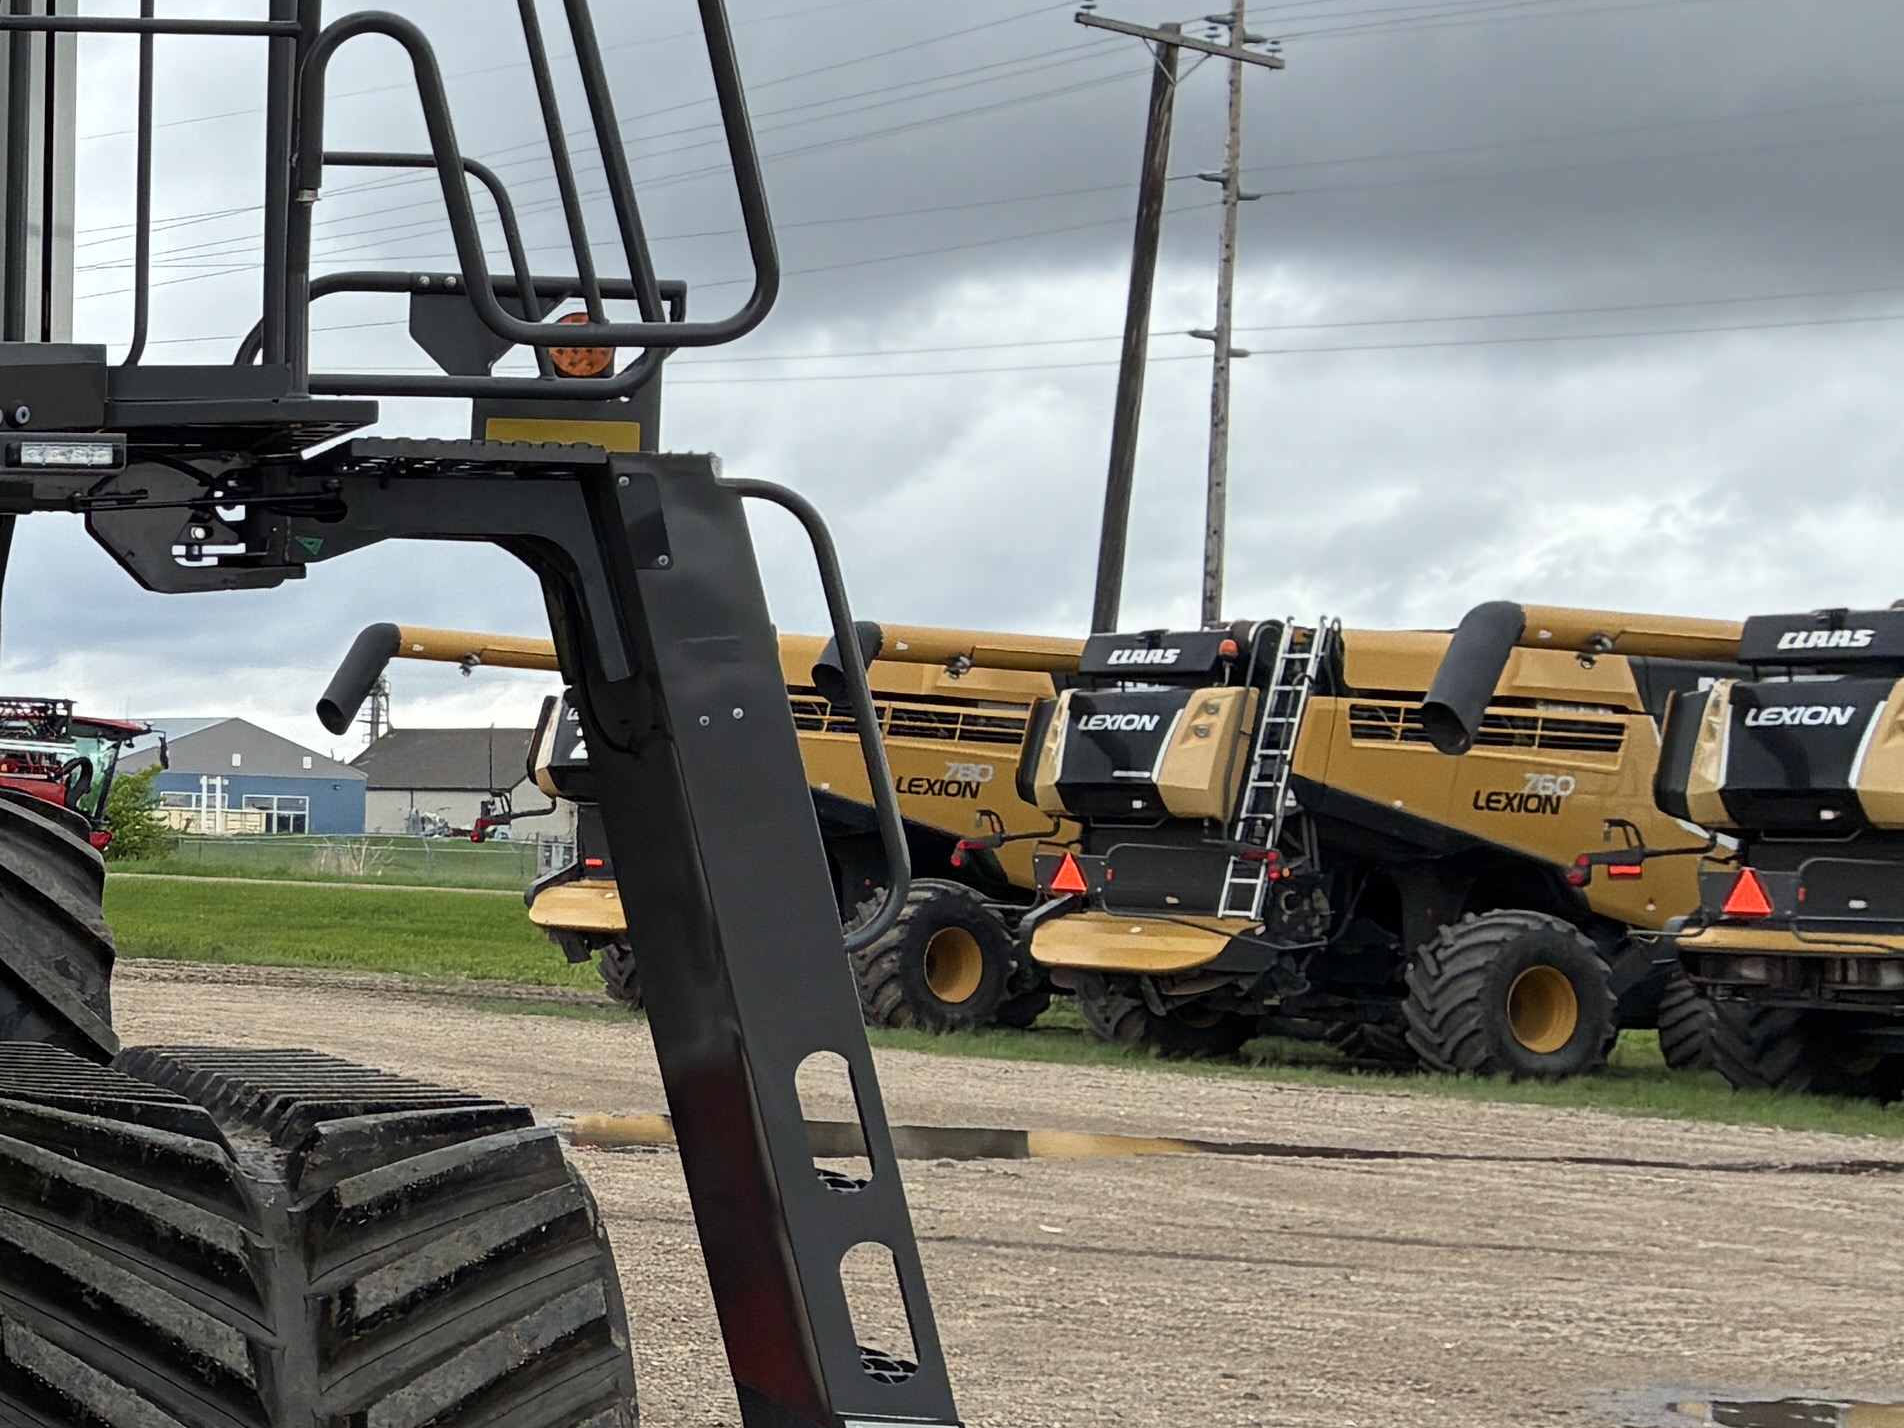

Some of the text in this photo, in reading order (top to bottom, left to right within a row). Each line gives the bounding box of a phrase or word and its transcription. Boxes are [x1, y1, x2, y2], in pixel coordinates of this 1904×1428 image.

[1776, 629, 1877, 651] CLAAS
[1106, 648, 1182, 665] CLAAS
[1077, 714, 1161, 731] LEXION
[1744, 705, 1857, 727] LEXION
[894, 775, 981, 799] LEXION
[1472, 789, 1562, 815] LEXION
